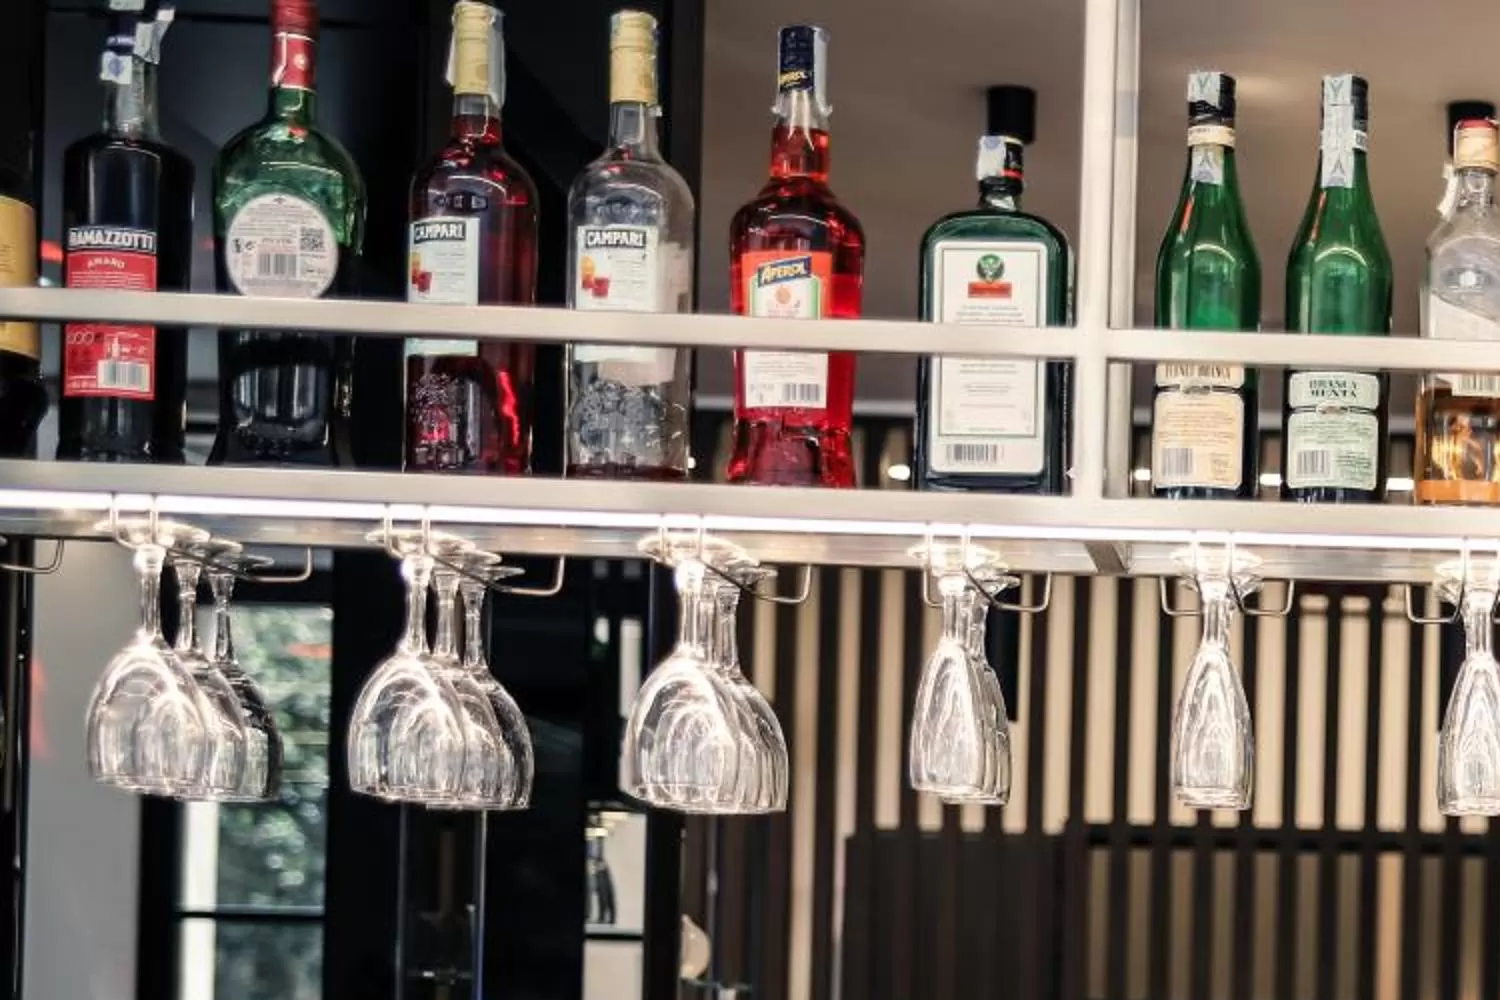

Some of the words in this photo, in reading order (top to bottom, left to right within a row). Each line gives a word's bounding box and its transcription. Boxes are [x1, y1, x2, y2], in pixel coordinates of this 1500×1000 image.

[69, 228, 153, 250] RAMAZZOTTI
[414, 223, 465, 241] CAMPARI
[587, 230, 644, 247] CAMPARI
[761, 261, 807, 284] APEROL
